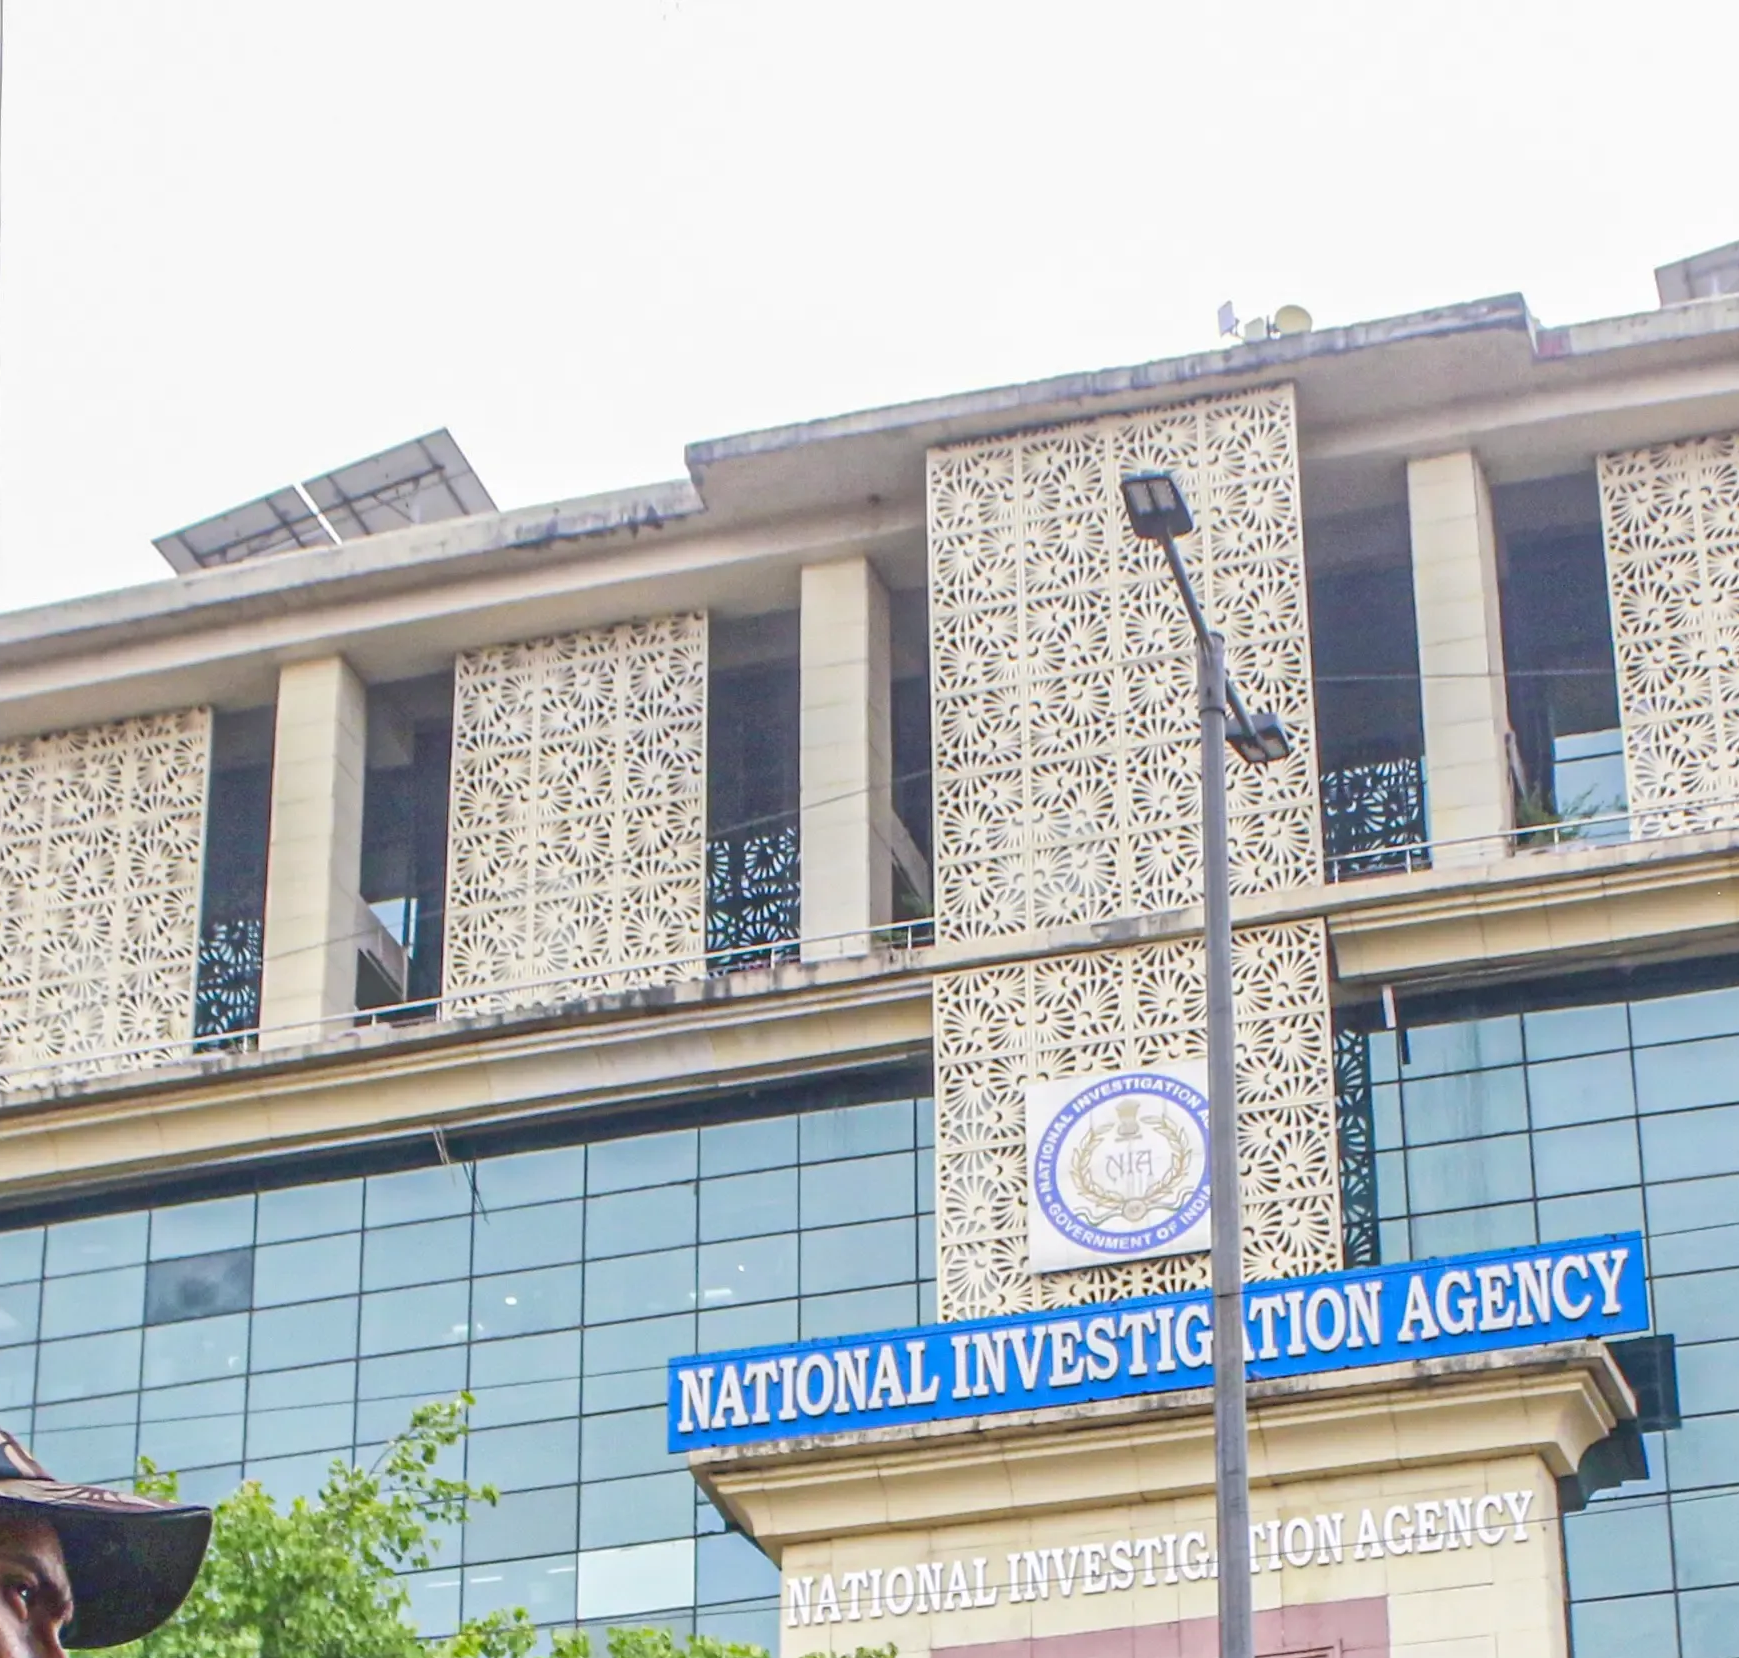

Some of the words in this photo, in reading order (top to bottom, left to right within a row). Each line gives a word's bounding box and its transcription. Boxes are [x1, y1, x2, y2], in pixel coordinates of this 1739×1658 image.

[1037, 1114, 1074, 1194] NATIONAL
[1072, 1077, 1202, 1114] INVESTIGATION
[1105, 1148, 1155, 1184] NIA
[1048, 1203, 1153, 1250] GOVERNMENT
[1156, 1220, 1178, 1240] OF
[677, 1341, 940, 1434] NATIONAL
[1398, 1249, 1629, 1343] AGENCY
[786, 1557, 998, 1628] NATIONAL
[1006, 1512, 1345, 1603] INVESTIGTION
[1353, 1490, 1534, 1561] AGENCY
